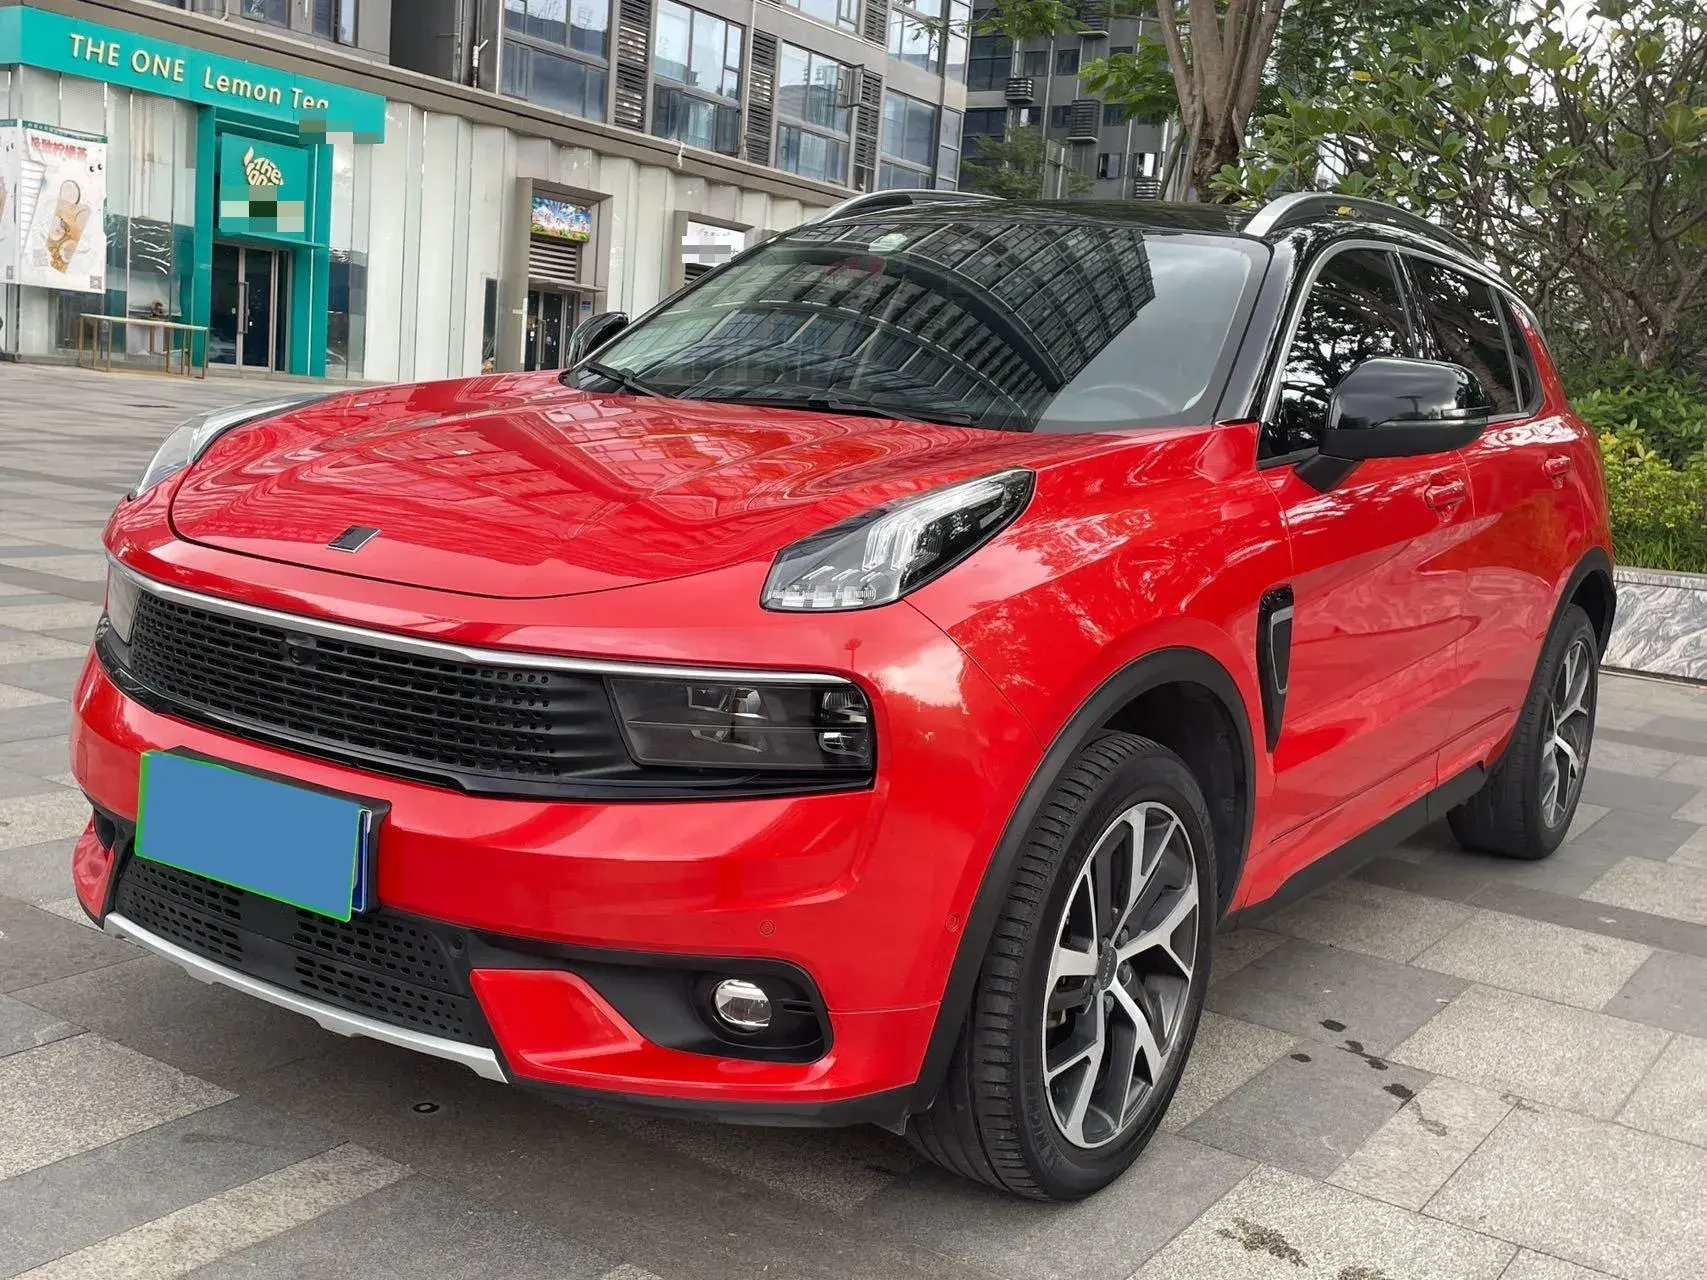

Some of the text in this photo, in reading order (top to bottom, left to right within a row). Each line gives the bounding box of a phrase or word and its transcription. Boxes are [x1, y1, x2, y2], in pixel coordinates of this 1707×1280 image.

[70, 33, 121, 67] THE
[131, 49, 186, 82] ONE
[204, 66, 281, 105] Lemon
